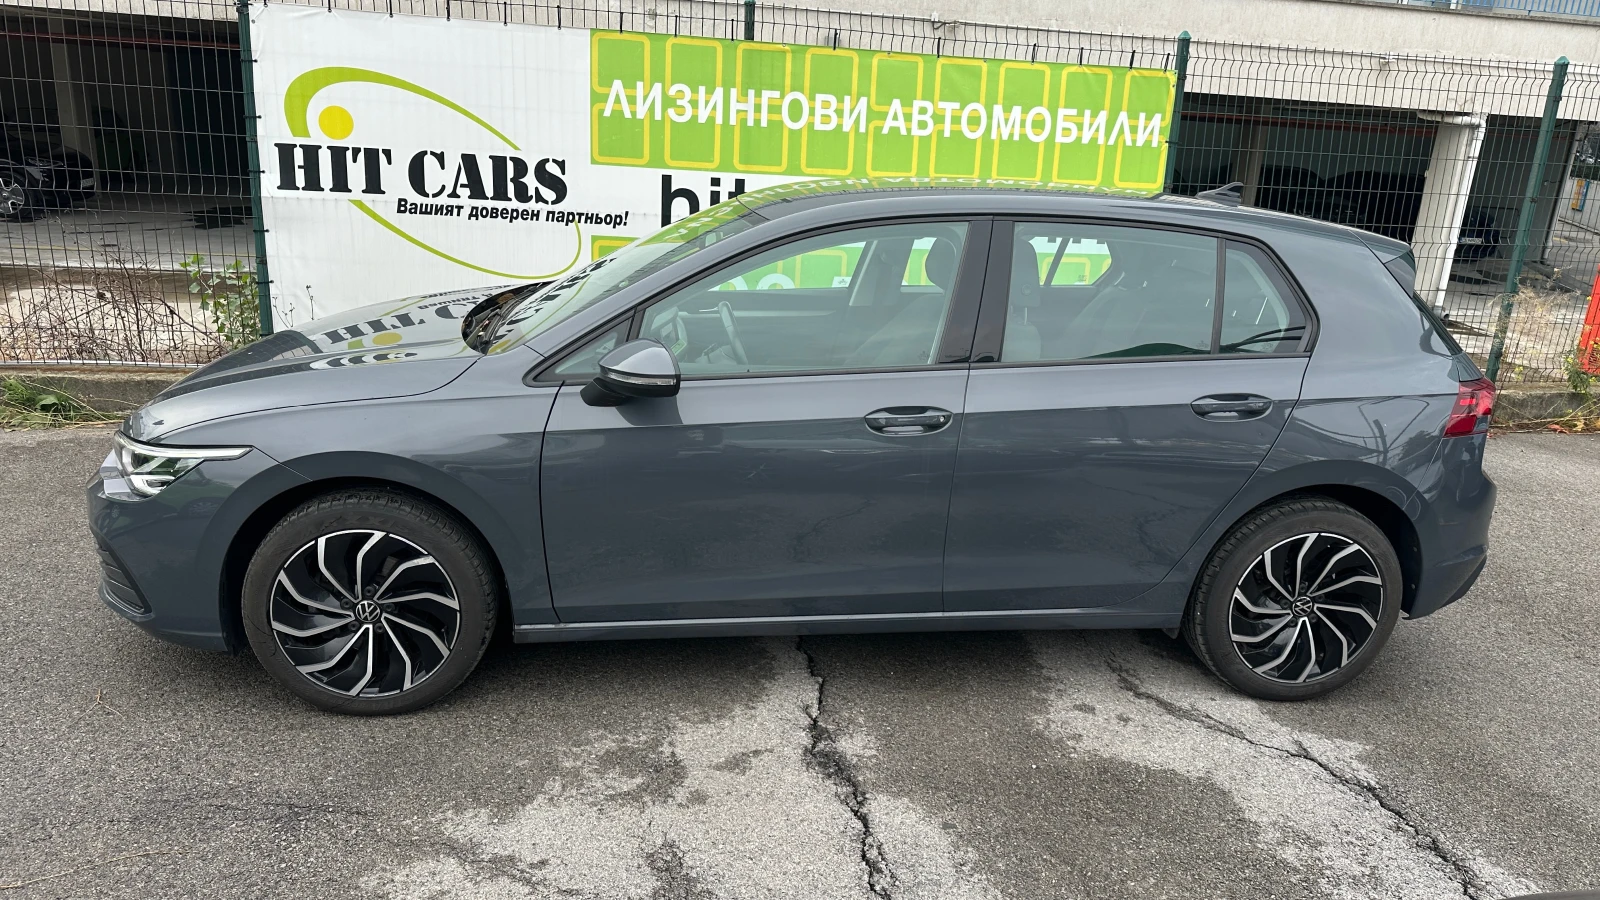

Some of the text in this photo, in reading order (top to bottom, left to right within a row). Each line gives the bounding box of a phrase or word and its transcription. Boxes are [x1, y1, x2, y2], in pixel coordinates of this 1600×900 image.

[602, 79, 1162, 148] ЛИЗИНГОВИ АВТОМОБИЛИ
[274, 142, 568, 206] HIT CARS
[396, 198, 630, 229] Вашият доверен партньор!
